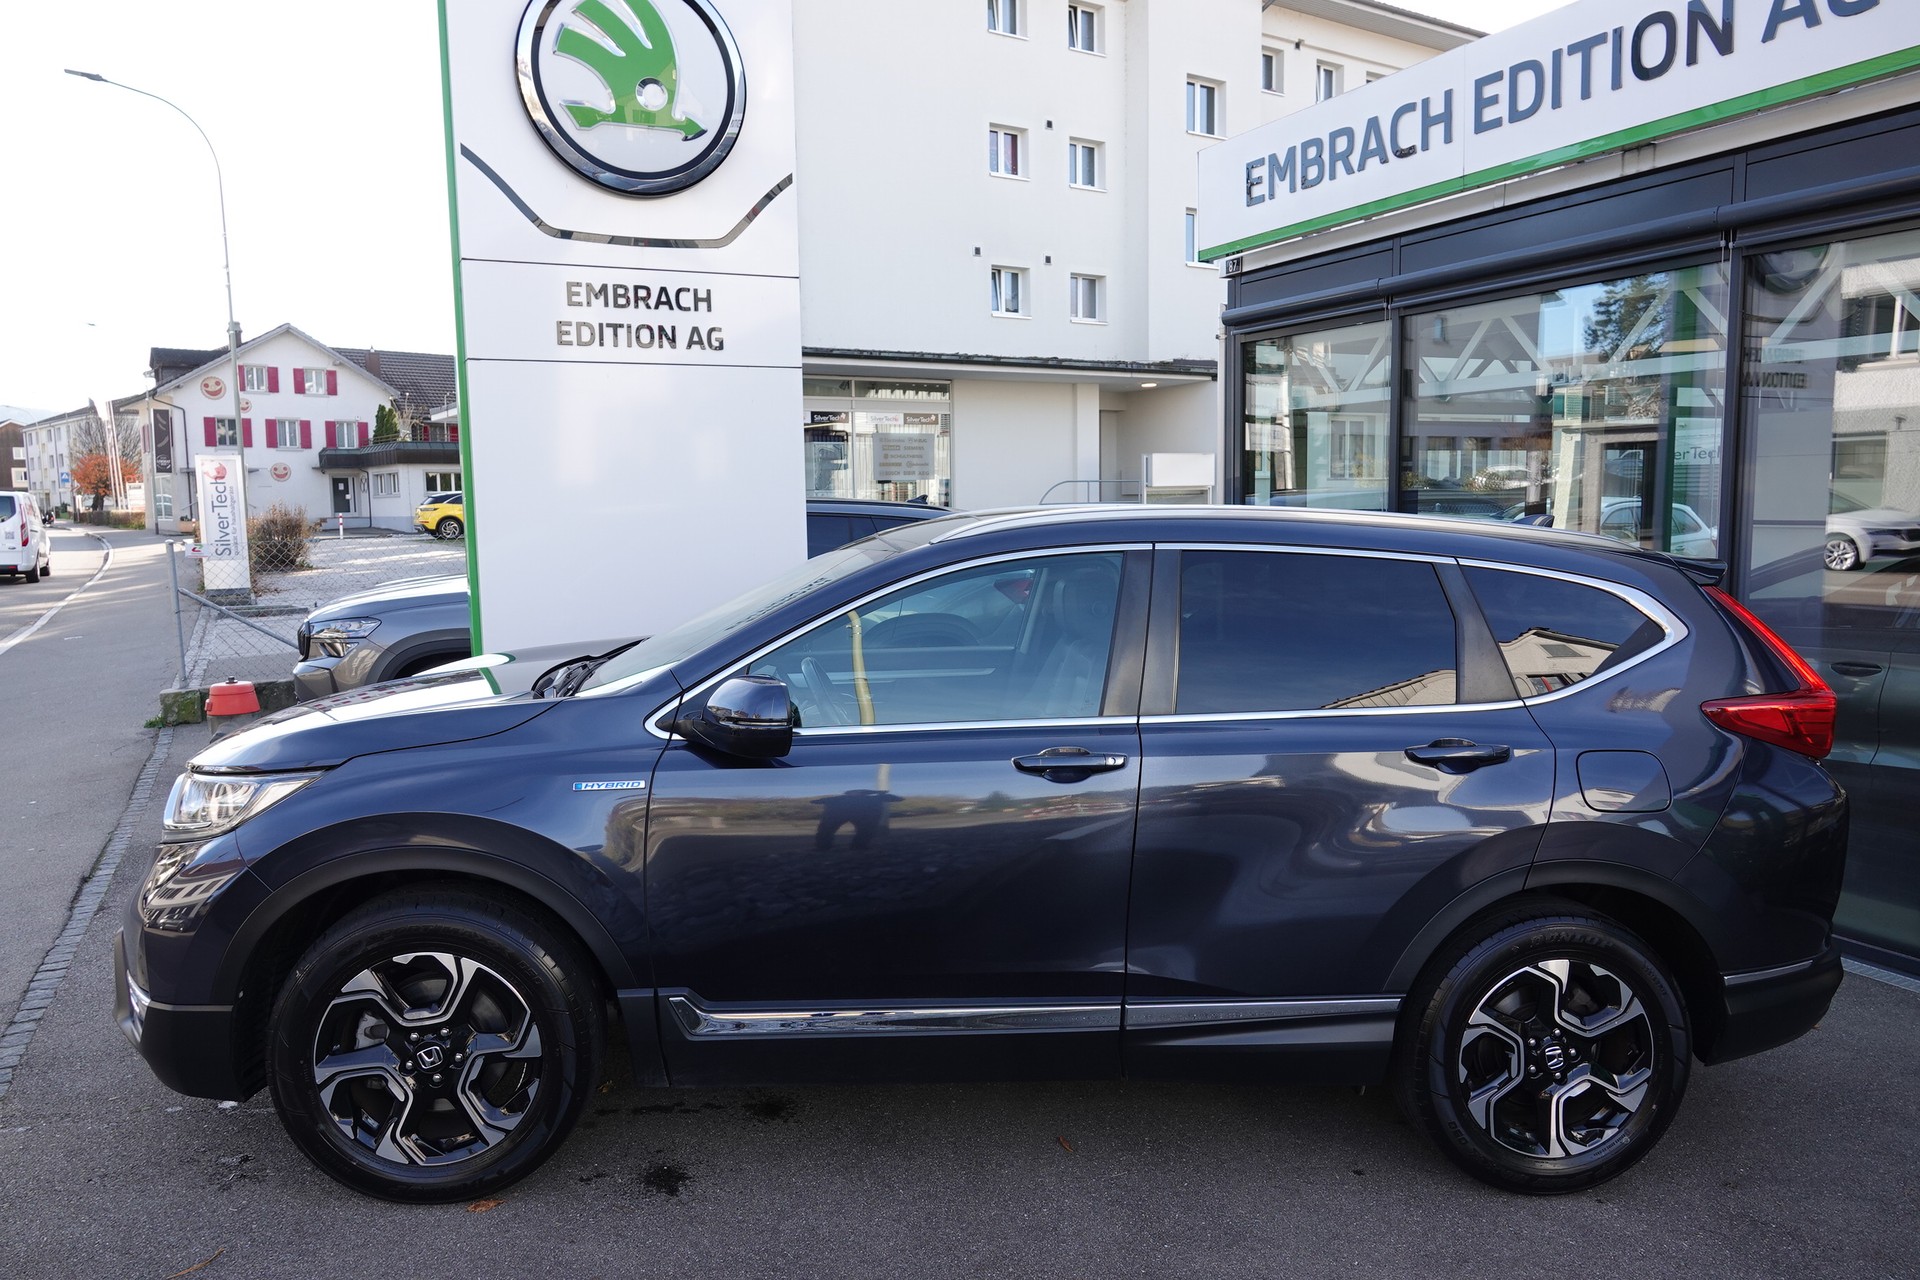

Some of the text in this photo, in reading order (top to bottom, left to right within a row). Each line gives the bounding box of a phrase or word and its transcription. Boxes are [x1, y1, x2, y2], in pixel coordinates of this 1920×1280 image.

[1246, 88, 1454, 207] EMBRACH
[1473, 0, 1734, 135] EDITION
[566, 281, 712, 312] EMBRACH
[556, 320, 724, 351] EDITION AG
[584, 781, 641, 789] HYBRID
